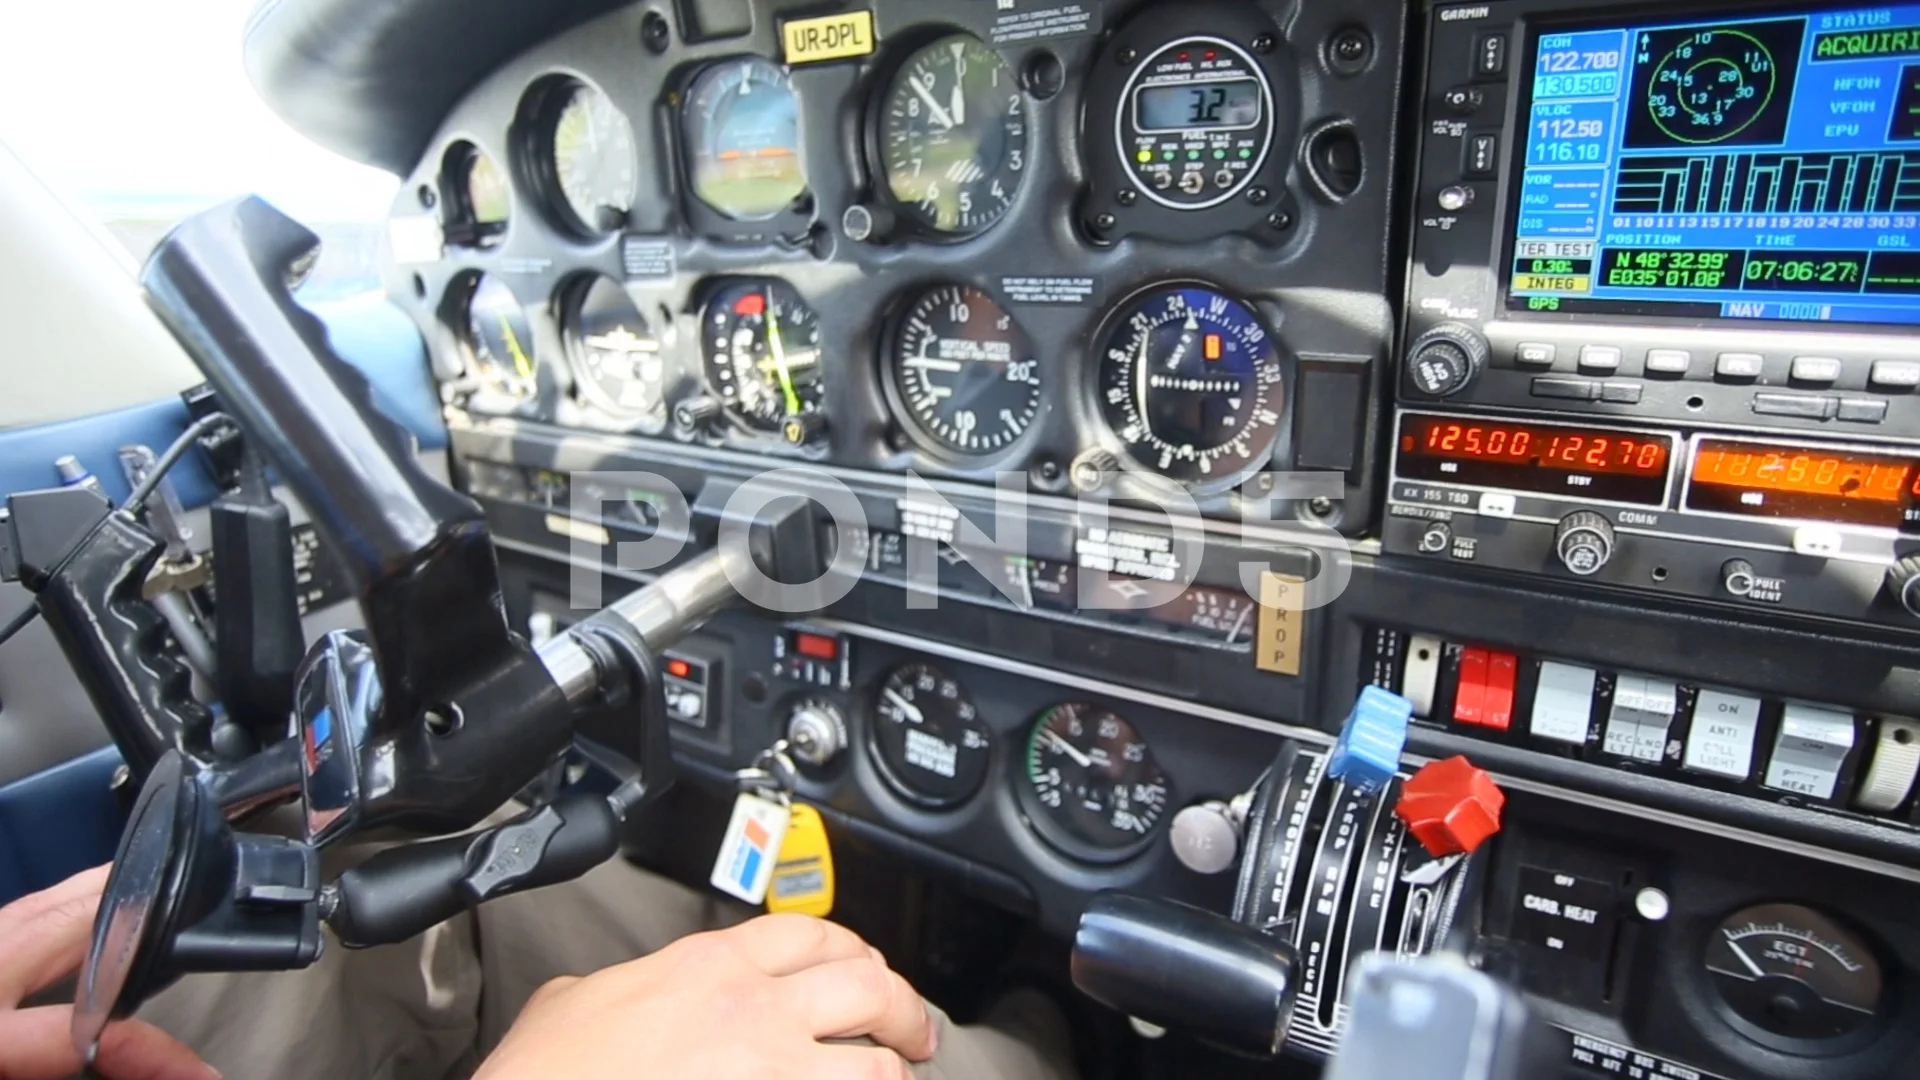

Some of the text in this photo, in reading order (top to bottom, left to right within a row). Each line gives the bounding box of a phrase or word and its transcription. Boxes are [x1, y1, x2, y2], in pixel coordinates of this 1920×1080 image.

[1441, 6, 1489, 22] GARMIN
[1821, 10, 1892, 28] STATUS
[793, 22, 863, 53] UR-DPL
[1487, 37, 1498, 50] C
[1543, 37, 1572, 49] COM
[1695, 32, 1712, 44] 10
[1676, 46, 1693, 59] 18
[1540, 51, 1619, 73] 122.700
[922, 71, 936, 92] 9
[1538, 75, 1615, 96] 130.500
[907, 97, 920, 118] 8
[1008, 94, 1021, 116] 2
[1536, 104, 1572, 117] VLOC
[1537, 119, 1604, 139] 112.50
[1478, 139, 1488, 150] V
[1535, 142, 1601, 161] 116.10
[911, 158, 923, 177] 7
[1008, 150, 1022, 171] 3
[1526, 174, 1552, 185] VOR
[926, 181, 939, 200] 6
[990, 179, 1004, 197] 4
[959, 191, 972, 212] 5
[1524, 193, 1549, 205] RAD
[1521, 217, 1544, 230] DIS
[1605, 233, 1682, 245] POSITION
[1755, 234, 1797, 246] TIME
[1520, 243, 1592, 257] TER TEST
[1616, 252, 1630, 267] N
[1527, 276, 1575, 290] INTEG
[1166, 295, 1185, 312] 24
[1210, 296, 1229, 315] W
[1528, 296, 1561, 311] GPS
[1728, 303, 1765, 317] NAV
[950, 304, 969, 322] 10
[1129, 312, 1149, 332] 21
[1243, 322, 1265, 344] 30
[1109, 348, 1126, 363] S
[1007, 362, 1030, 381] 20
[1264, 363, 1282, 384] 33
[1259, 408, 1279, 426] N
[1428, 425, 1658, 469] 125.00 122.70
[1567, 474, 1592, 487] STBY
[1403, 488, 1419, 498] KX
[1424, 489, 1442, 501] 155
[1618, 510, 1658, 526] COMM
[1453, 539, 1476, 549] PULL
[1452, 547, 1475, 559] TEST
[1755, 578, 1781, 591] PULL
[1749, 589, 1783, 602] IDENT
[1272, 583, 1289, 665] PROP
[1718, 702, 1740, 715] ON
[1607, 731, 1633, 745] REC
[1708, 724, 1739, 738] ANTI
[1635, 735, 1663, 749] LND
[1638, 747, 1656, 759] LT
[1781, 779, 1816, 794] HEAT
[1334, 802, 1358, 850] PROP
[1553, 873, 1576, 888] OFF
[1316, 866, 1338, 916] RPM
[1523, 893, 1598, 924] CARB. HEAT
[1546, 935, 1564, 950] ON
[1772, 939, 1809, 957] EGT
